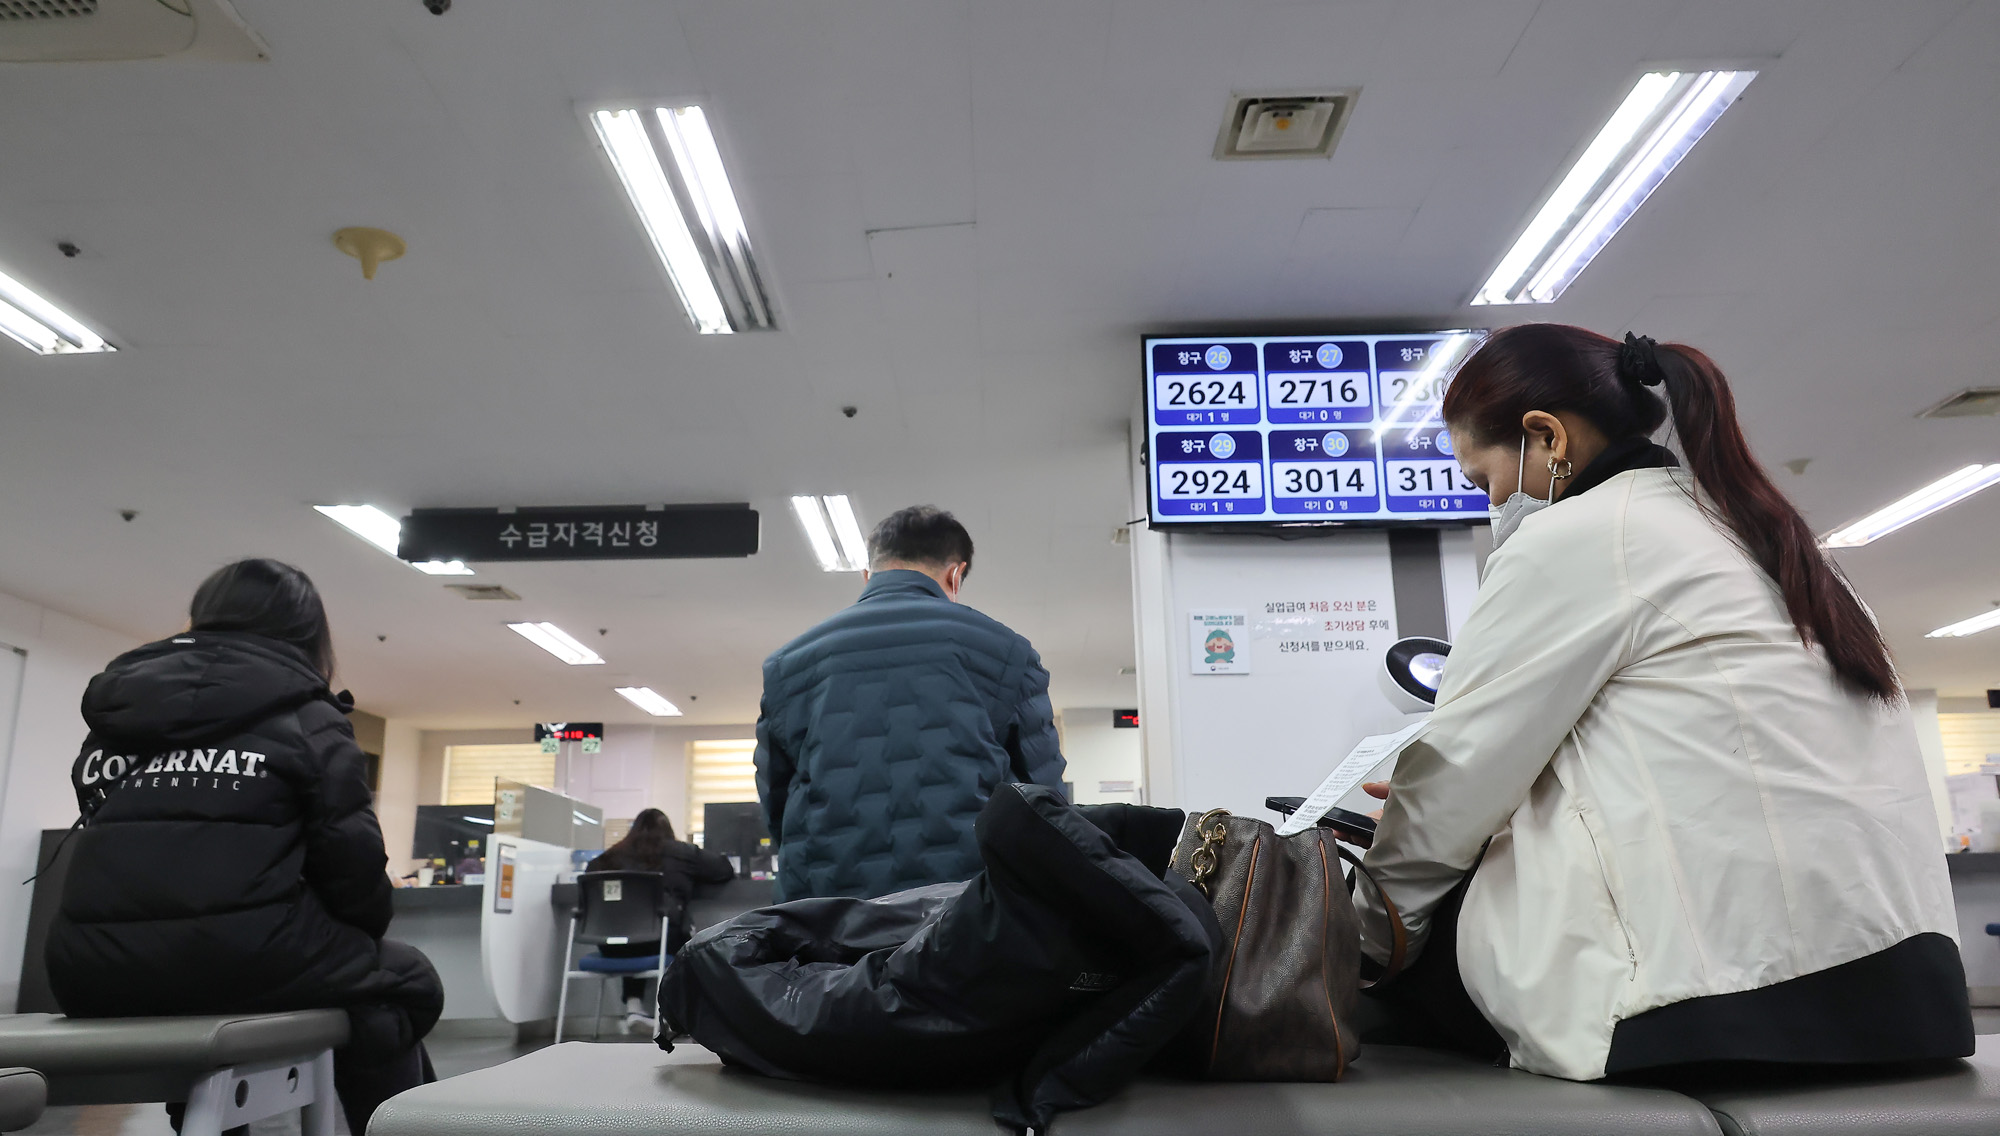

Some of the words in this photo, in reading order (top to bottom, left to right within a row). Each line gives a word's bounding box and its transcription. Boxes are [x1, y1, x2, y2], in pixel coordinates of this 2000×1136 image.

[1178, 352, 1202, 365] 창구
[1210, 351, 1228, 364] 26
[1289, 350, 1313, 363] 창구
[1321, 349, 1338, 362] 27
[1400, 348, 1424, 361] 창구
[1168, 381, 1246, 405] 2624
[1279, 379, 1358, 403] 2716
[1186, 413, 1202, 422] 대기
[1207, 412, 1215, 422] 1
[1221, 412, 1230, 422] 명
[1299, 411, 1315, 420] 대기
[1319, 410, 1328, 421] 0
[1333, 411, 1342, 420] 명
[1181, 439, 1206, 453] 창구
[1214, 439, 1232, 452] 29
[1294, 438, 1319, 451] 창구
[1327, 437, 1345, 450] 30
[1408, 436, 1432, 450] 창구
[1441, 436, 1450, 449] 3
[1171, 470, 1251, 495] 2924
[1285, 468, 1365, 493] 3014
[1190, 502, 1207, 512] 대기
[1211, 501, 1219, 512] 1
[1225, 502, 1234, 512] 명
[1304, 501, 1321, 510] 대기
[1325, 500, 1334, 511] 0
[1339, 501, 1348, 510] 명
[1418, 499, 1435, 508] 대기
[1440, 498, 1449, 509] 0
[1453, 499, 1463, 508] 명
[499, 520, 659, 548] 수급자격신청
[1265, 601, 1306, 613] 실업급여
[1309, 600, 1329, 612] 처음
[1333, 600, 1353, 611] 오신
[1357, 600, 1377, 611] 분은
[1324, 620, 1365, 631] 초기상담
[1369, 619, 1390, 630] 후에
[1279, 641, 1320, 652] 신청서를
[1323, 640, 1369, 652] 받으세요.
[120, 775, 241, 791] THENTIC
